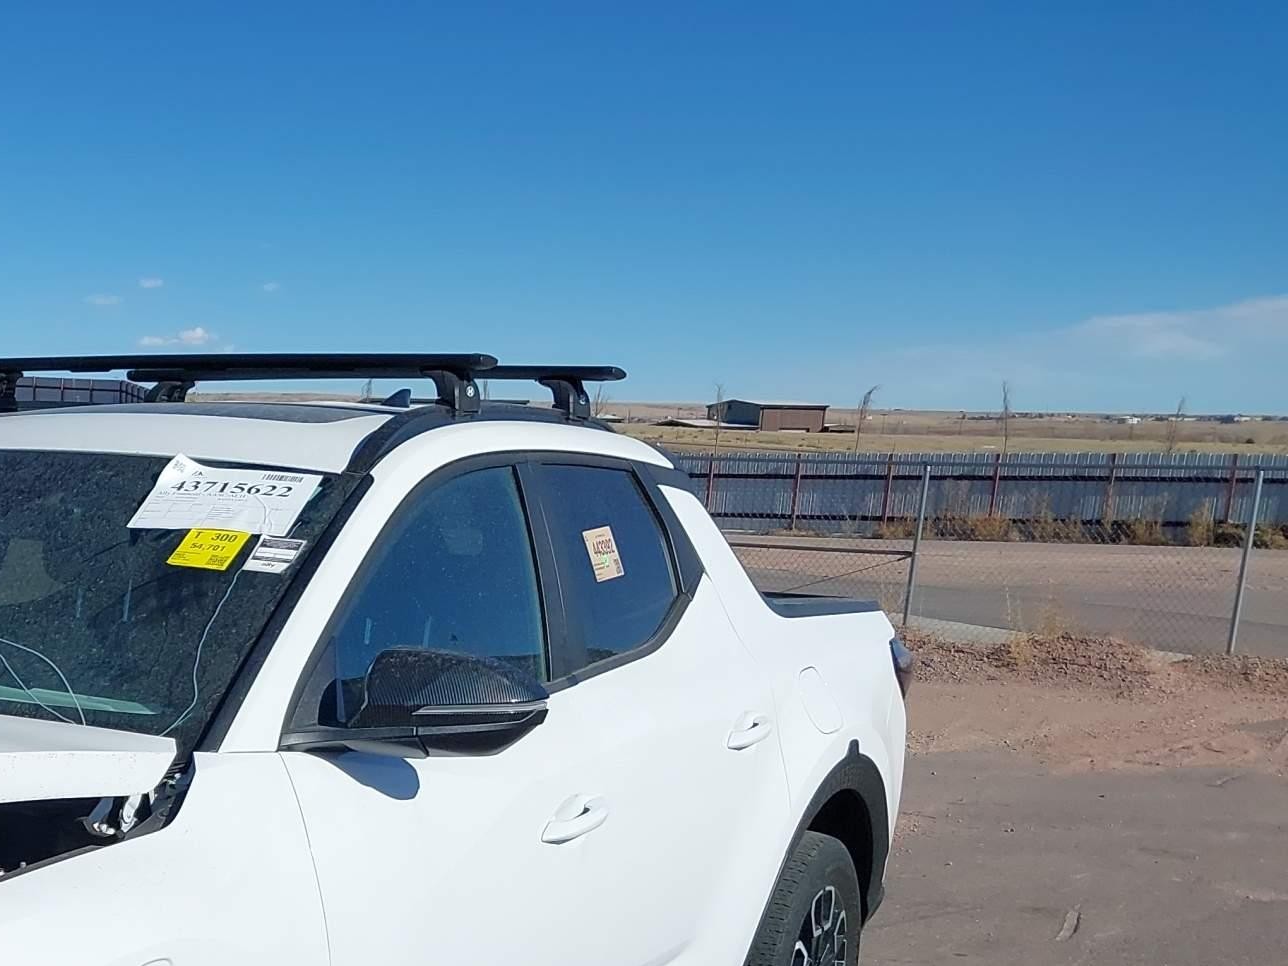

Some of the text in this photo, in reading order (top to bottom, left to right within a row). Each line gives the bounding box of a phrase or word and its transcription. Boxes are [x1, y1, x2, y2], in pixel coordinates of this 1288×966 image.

[170, 480, 294, 498] 43715622
[193, 531, 238, 543] T 300
[190, 542, 226, 551] 54,701
